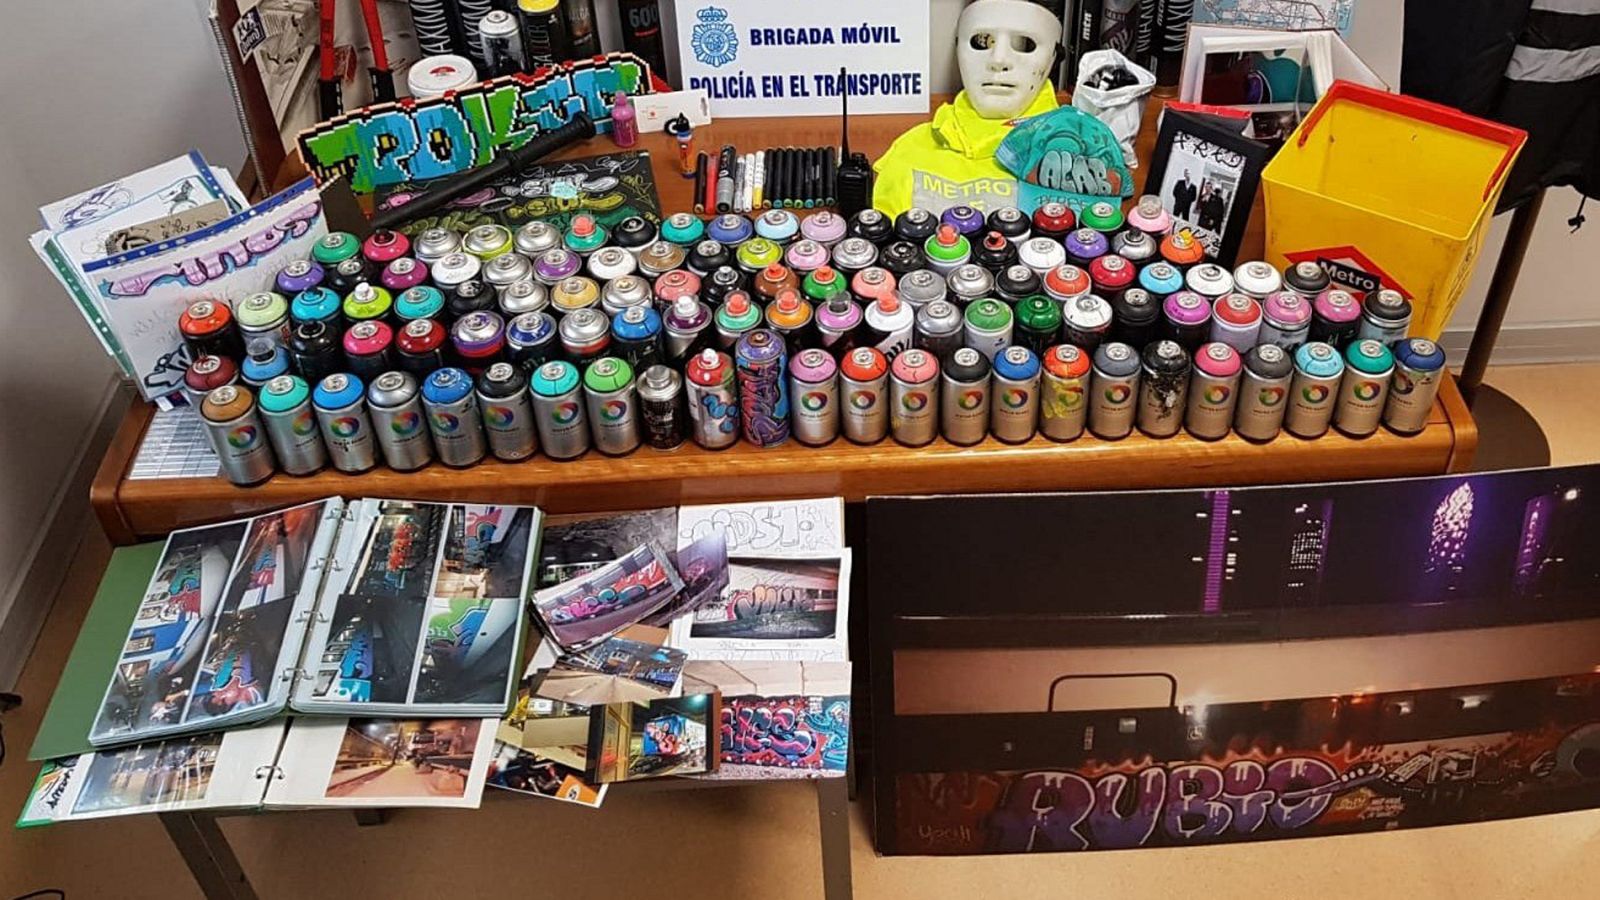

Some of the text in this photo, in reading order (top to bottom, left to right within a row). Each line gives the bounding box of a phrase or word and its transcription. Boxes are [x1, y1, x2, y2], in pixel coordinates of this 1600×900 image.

[750, 23, 900, 45] BRIGADA MÓVIL
[690, 71, 921, 98] POLICÍA EN EL TRANSPORTE
[923, 174, 1012, 199] METRO
[1320, 261, 1375, 290] Metro
